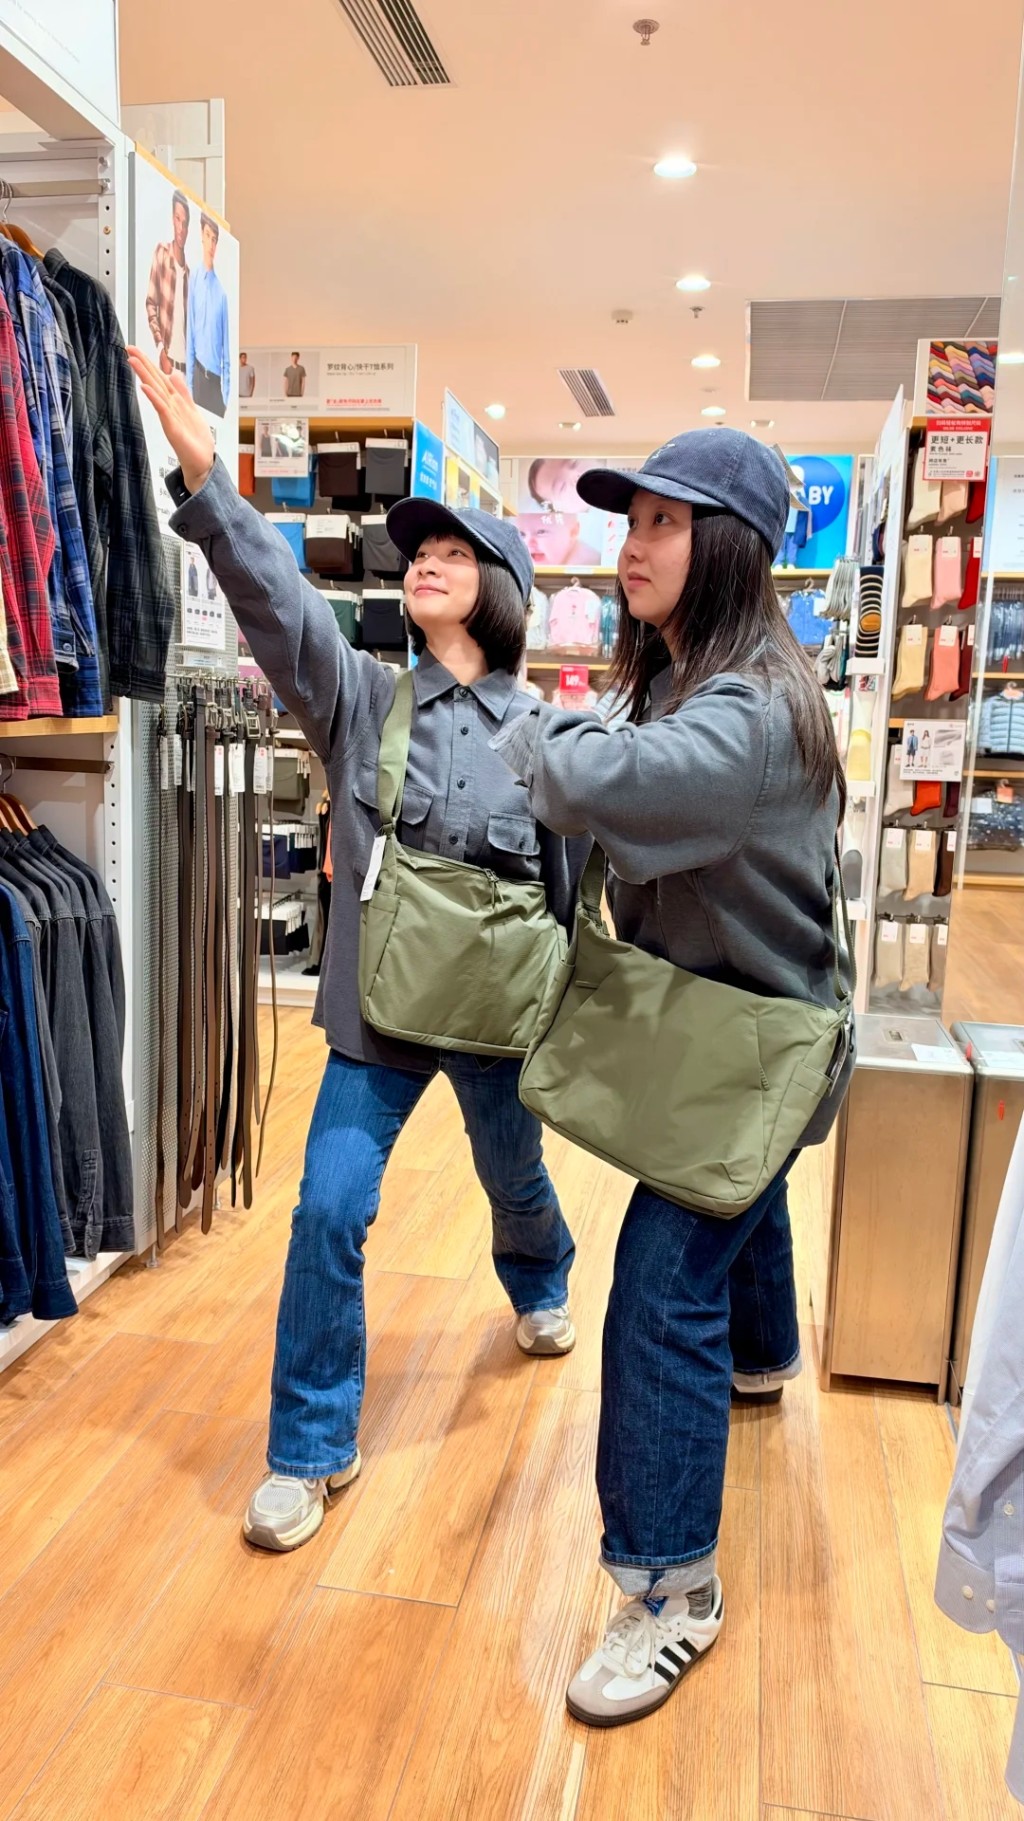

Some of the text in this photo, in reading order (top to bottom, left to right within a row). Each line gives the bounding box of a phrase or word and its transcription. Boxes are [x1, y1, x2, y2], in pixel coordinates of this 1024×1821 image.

[931, 435, 983, 444] 更短+更长款
